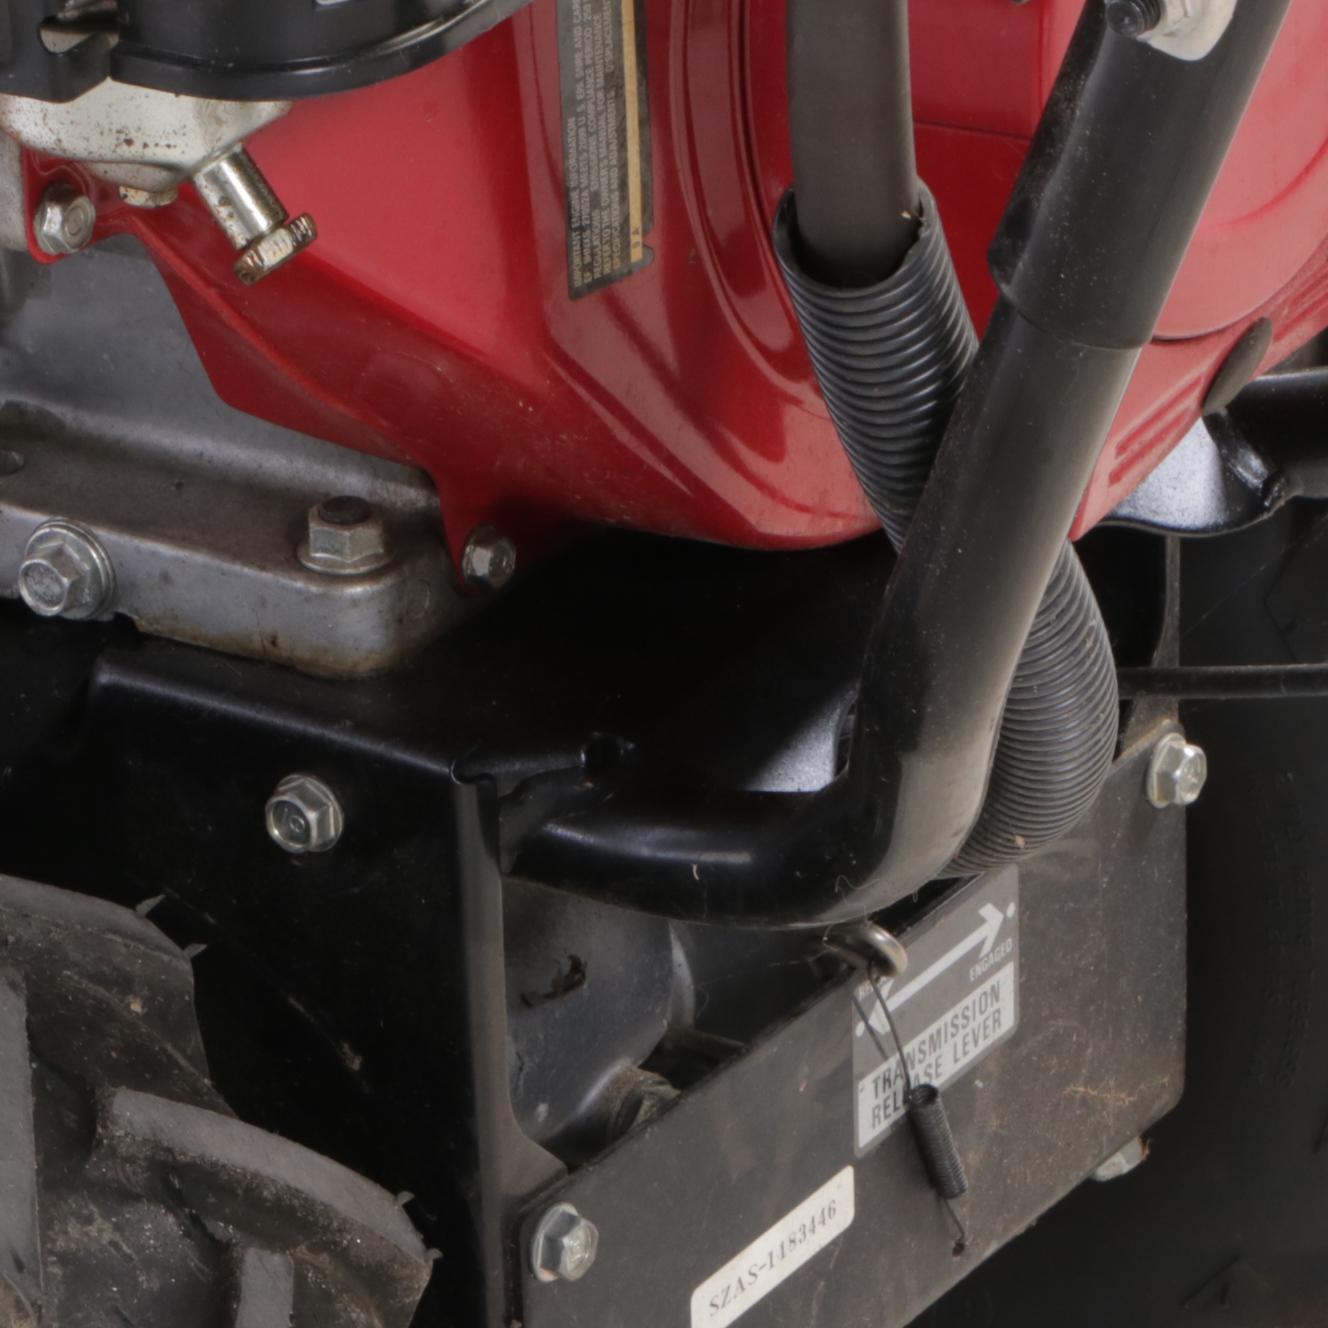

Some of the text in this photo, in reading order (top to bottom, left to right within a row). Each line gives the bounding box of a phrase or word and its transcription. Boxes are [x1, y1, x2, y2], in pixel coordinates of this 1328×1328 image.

[585, 67, 596, 132] COMPLIANCE
[567, 117, 582, 288] IMPORTANT ENGINE INFORMATION
[579, 152, 589, 188] MEETS
[603, 241, 611, 275] REFER
[610, 192, 621, 270] SPECIFICATIONS
[969, 937, 1012, 982] ENGAGED
[872, 981, 1001, 1099] TRANSMISSION
[872, 1009, 1001, 1129] RELASE LEVER
[708, 1199, 837, 1316] SZAS-1183446
